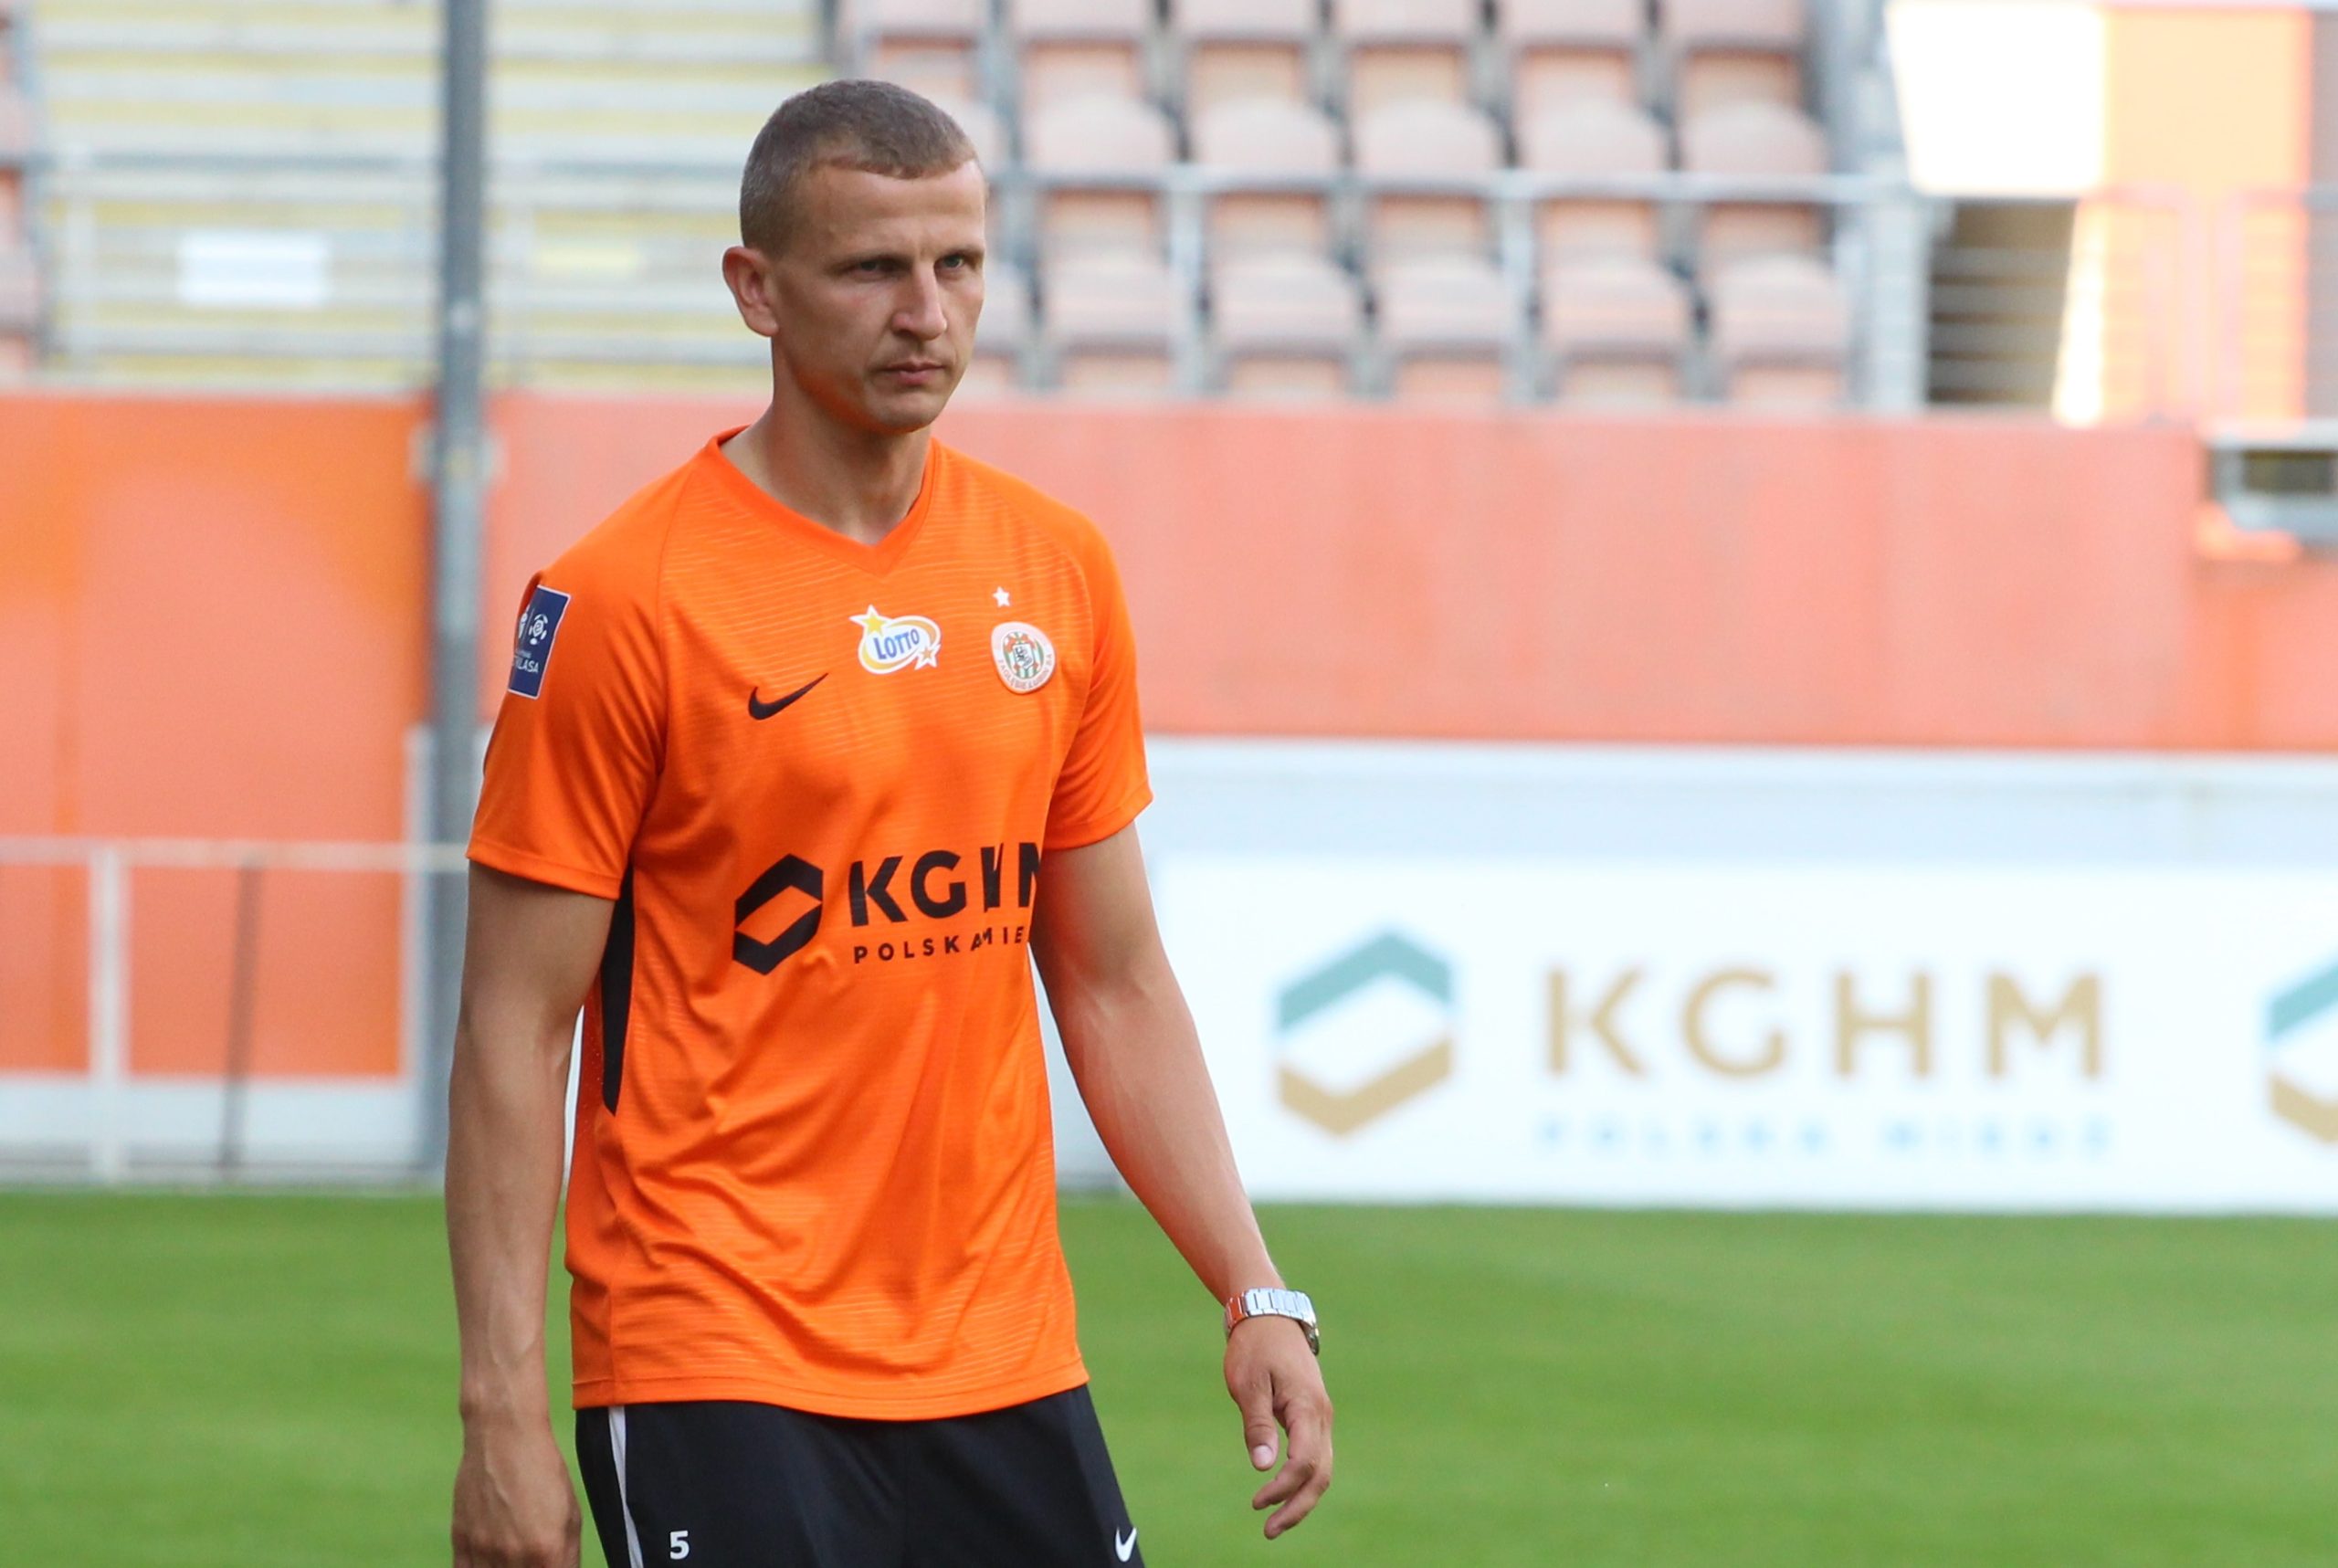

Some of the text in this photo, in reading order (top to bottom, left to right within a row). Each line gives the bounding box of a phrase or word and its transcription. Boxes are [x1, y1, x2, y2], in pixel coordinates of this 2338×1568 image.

[873, 628, 920, 659] LOTTO
[854, 926, 1025, 963] POLSKA MIE
[1544, 968, 2103, 1079] KGHM
[669, 1530, 690, 1560] 5
